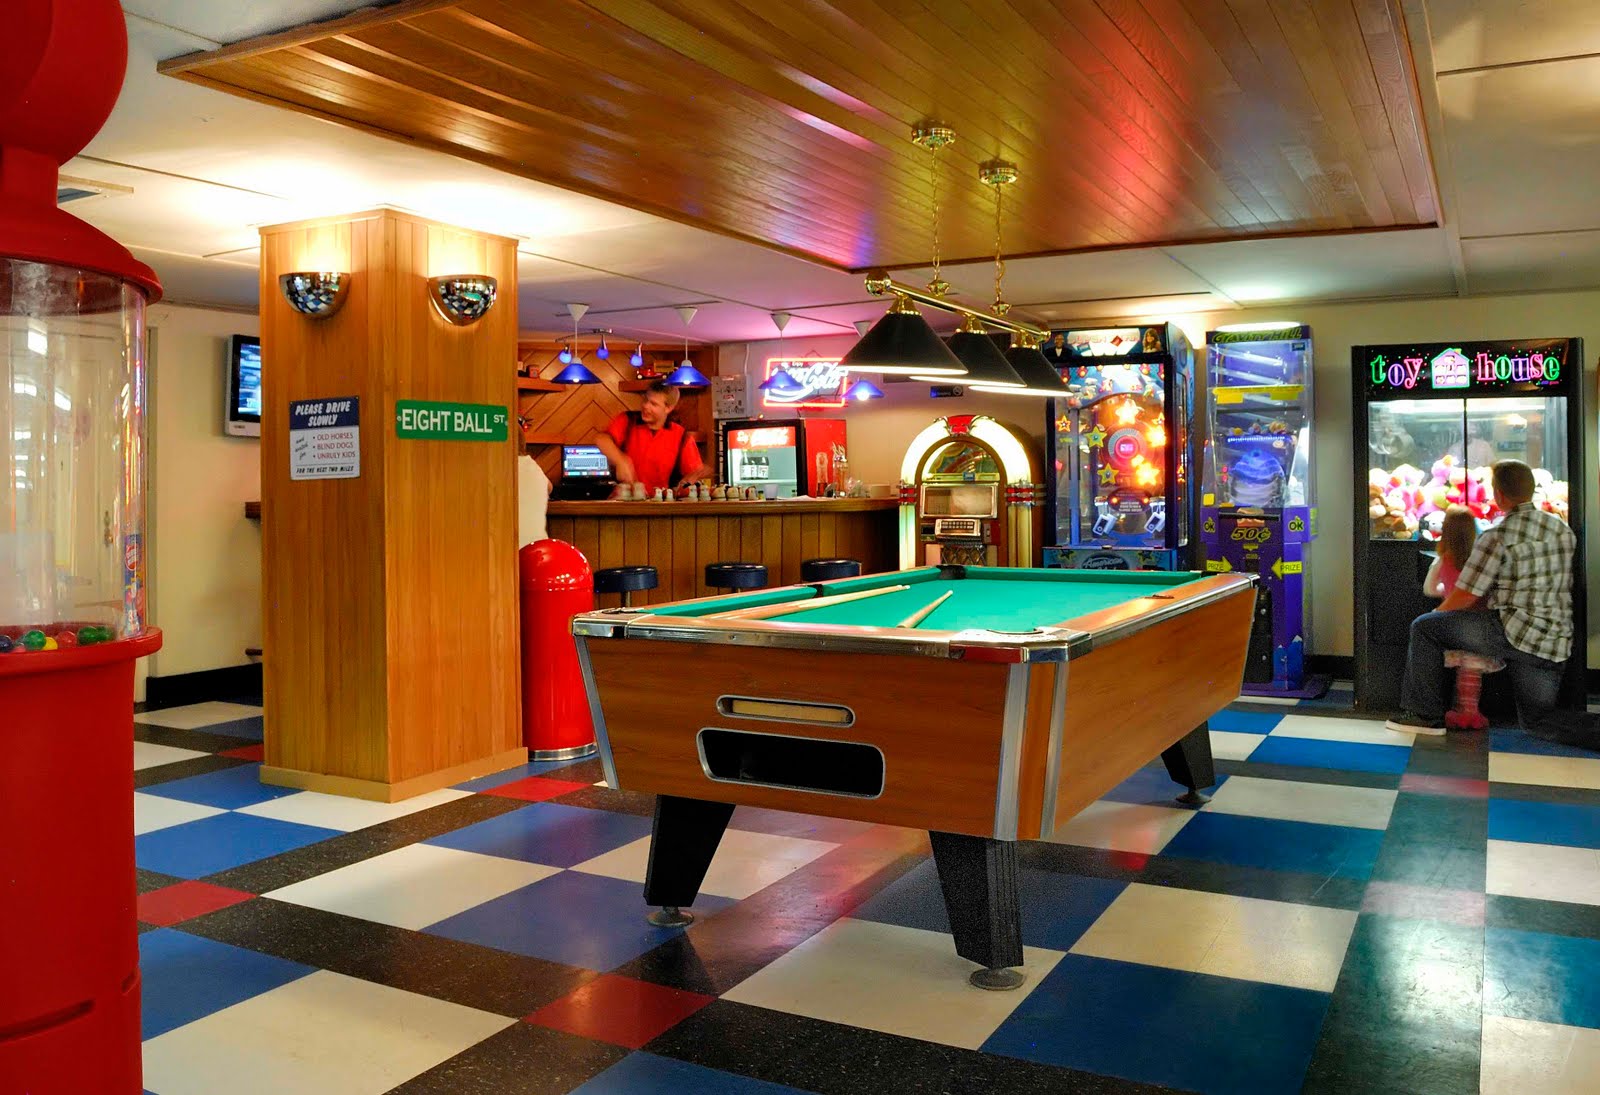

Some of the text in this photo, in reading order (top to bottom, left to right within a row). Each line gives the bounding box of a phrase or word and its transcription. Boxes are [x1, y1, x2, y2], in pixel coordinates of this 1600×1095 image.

[1371, 353, 1560, 389] toy house
[295, 400, 351, 416] PLEASE DRIVE
[308, 414, 338, 427] SLOWLY
[402, 408, 505, 433] EIGHT BALL ST
[330, 432, 353, 440] HORSES
[317, 452, 340, 460] UNRULY
[1203, 521, 1215, 532] OK
[1288, 521, 1305, 532] OK
[1231, 527, 1271, 542] 50¢
[1208, 561, 1224, 571] PRIZE
[1280, 563, 1300, 571] PRIZE
